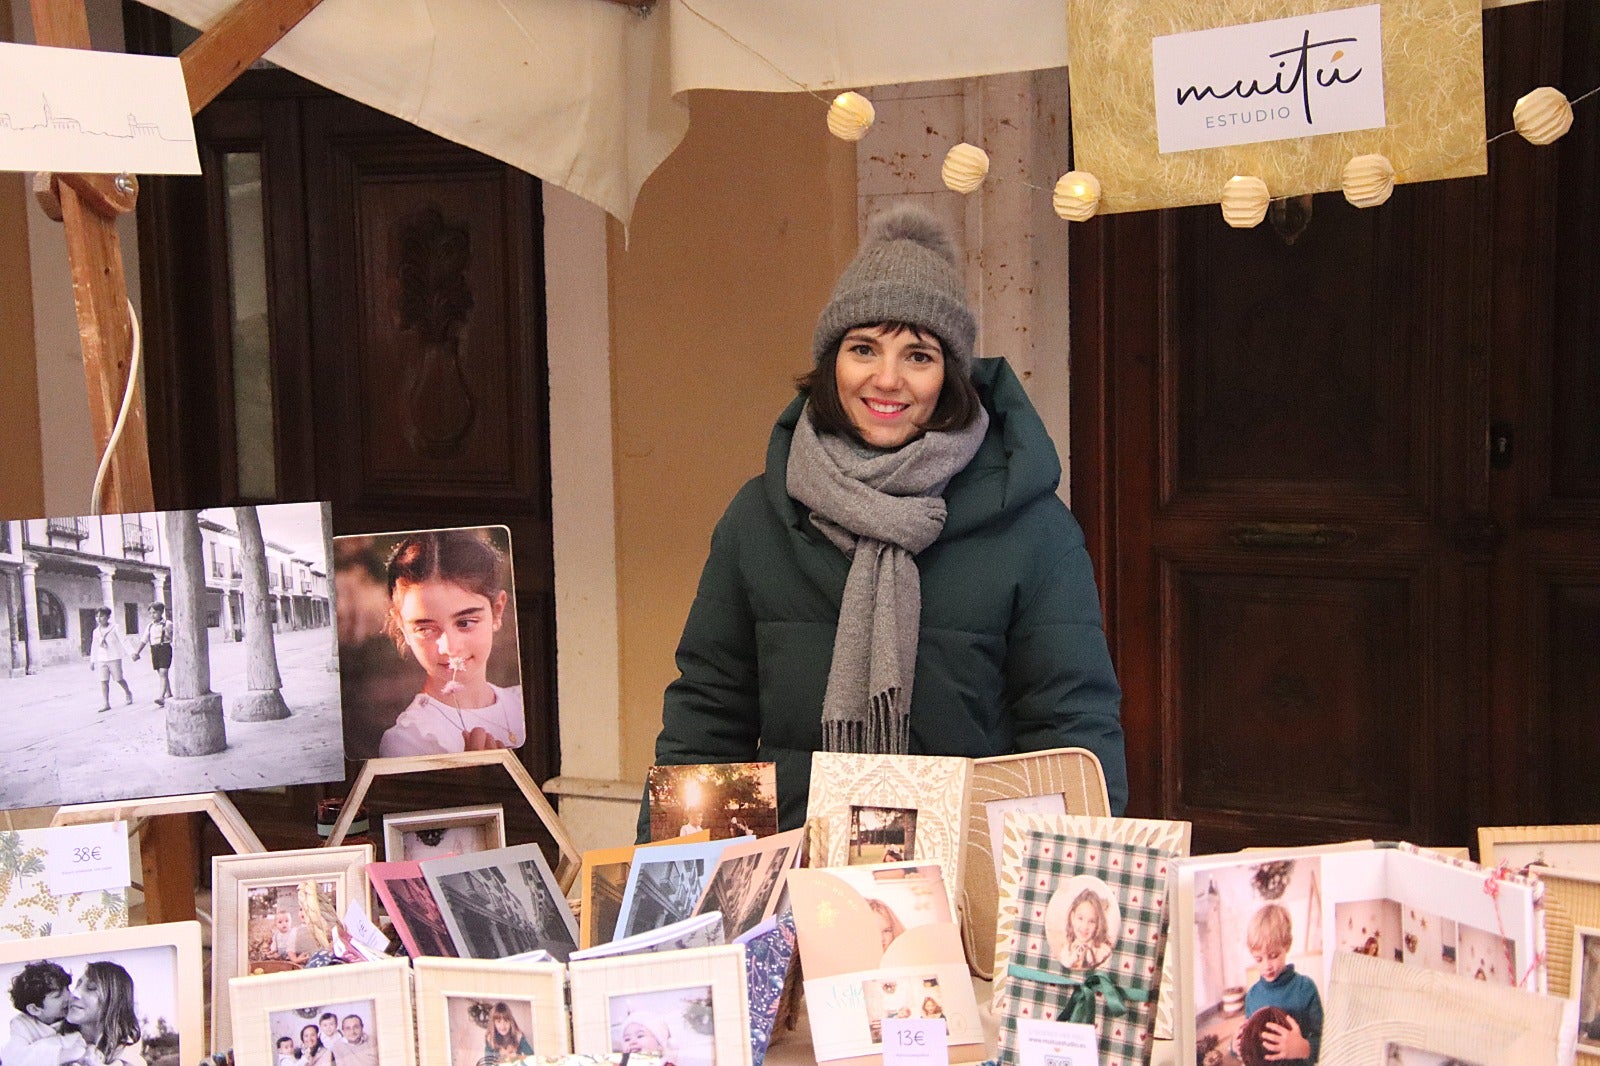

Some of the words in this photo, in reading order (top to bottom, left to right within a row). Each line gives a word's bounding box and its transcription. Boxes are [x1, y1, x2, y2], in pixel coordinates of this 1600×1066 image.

[1177, 29, 1362, 124] muitú
[1206, 106, 1290, 128] ESTUDIO
[72, 846, 102, 863] 38€
[897, 1029, 925, 1047] 13€
